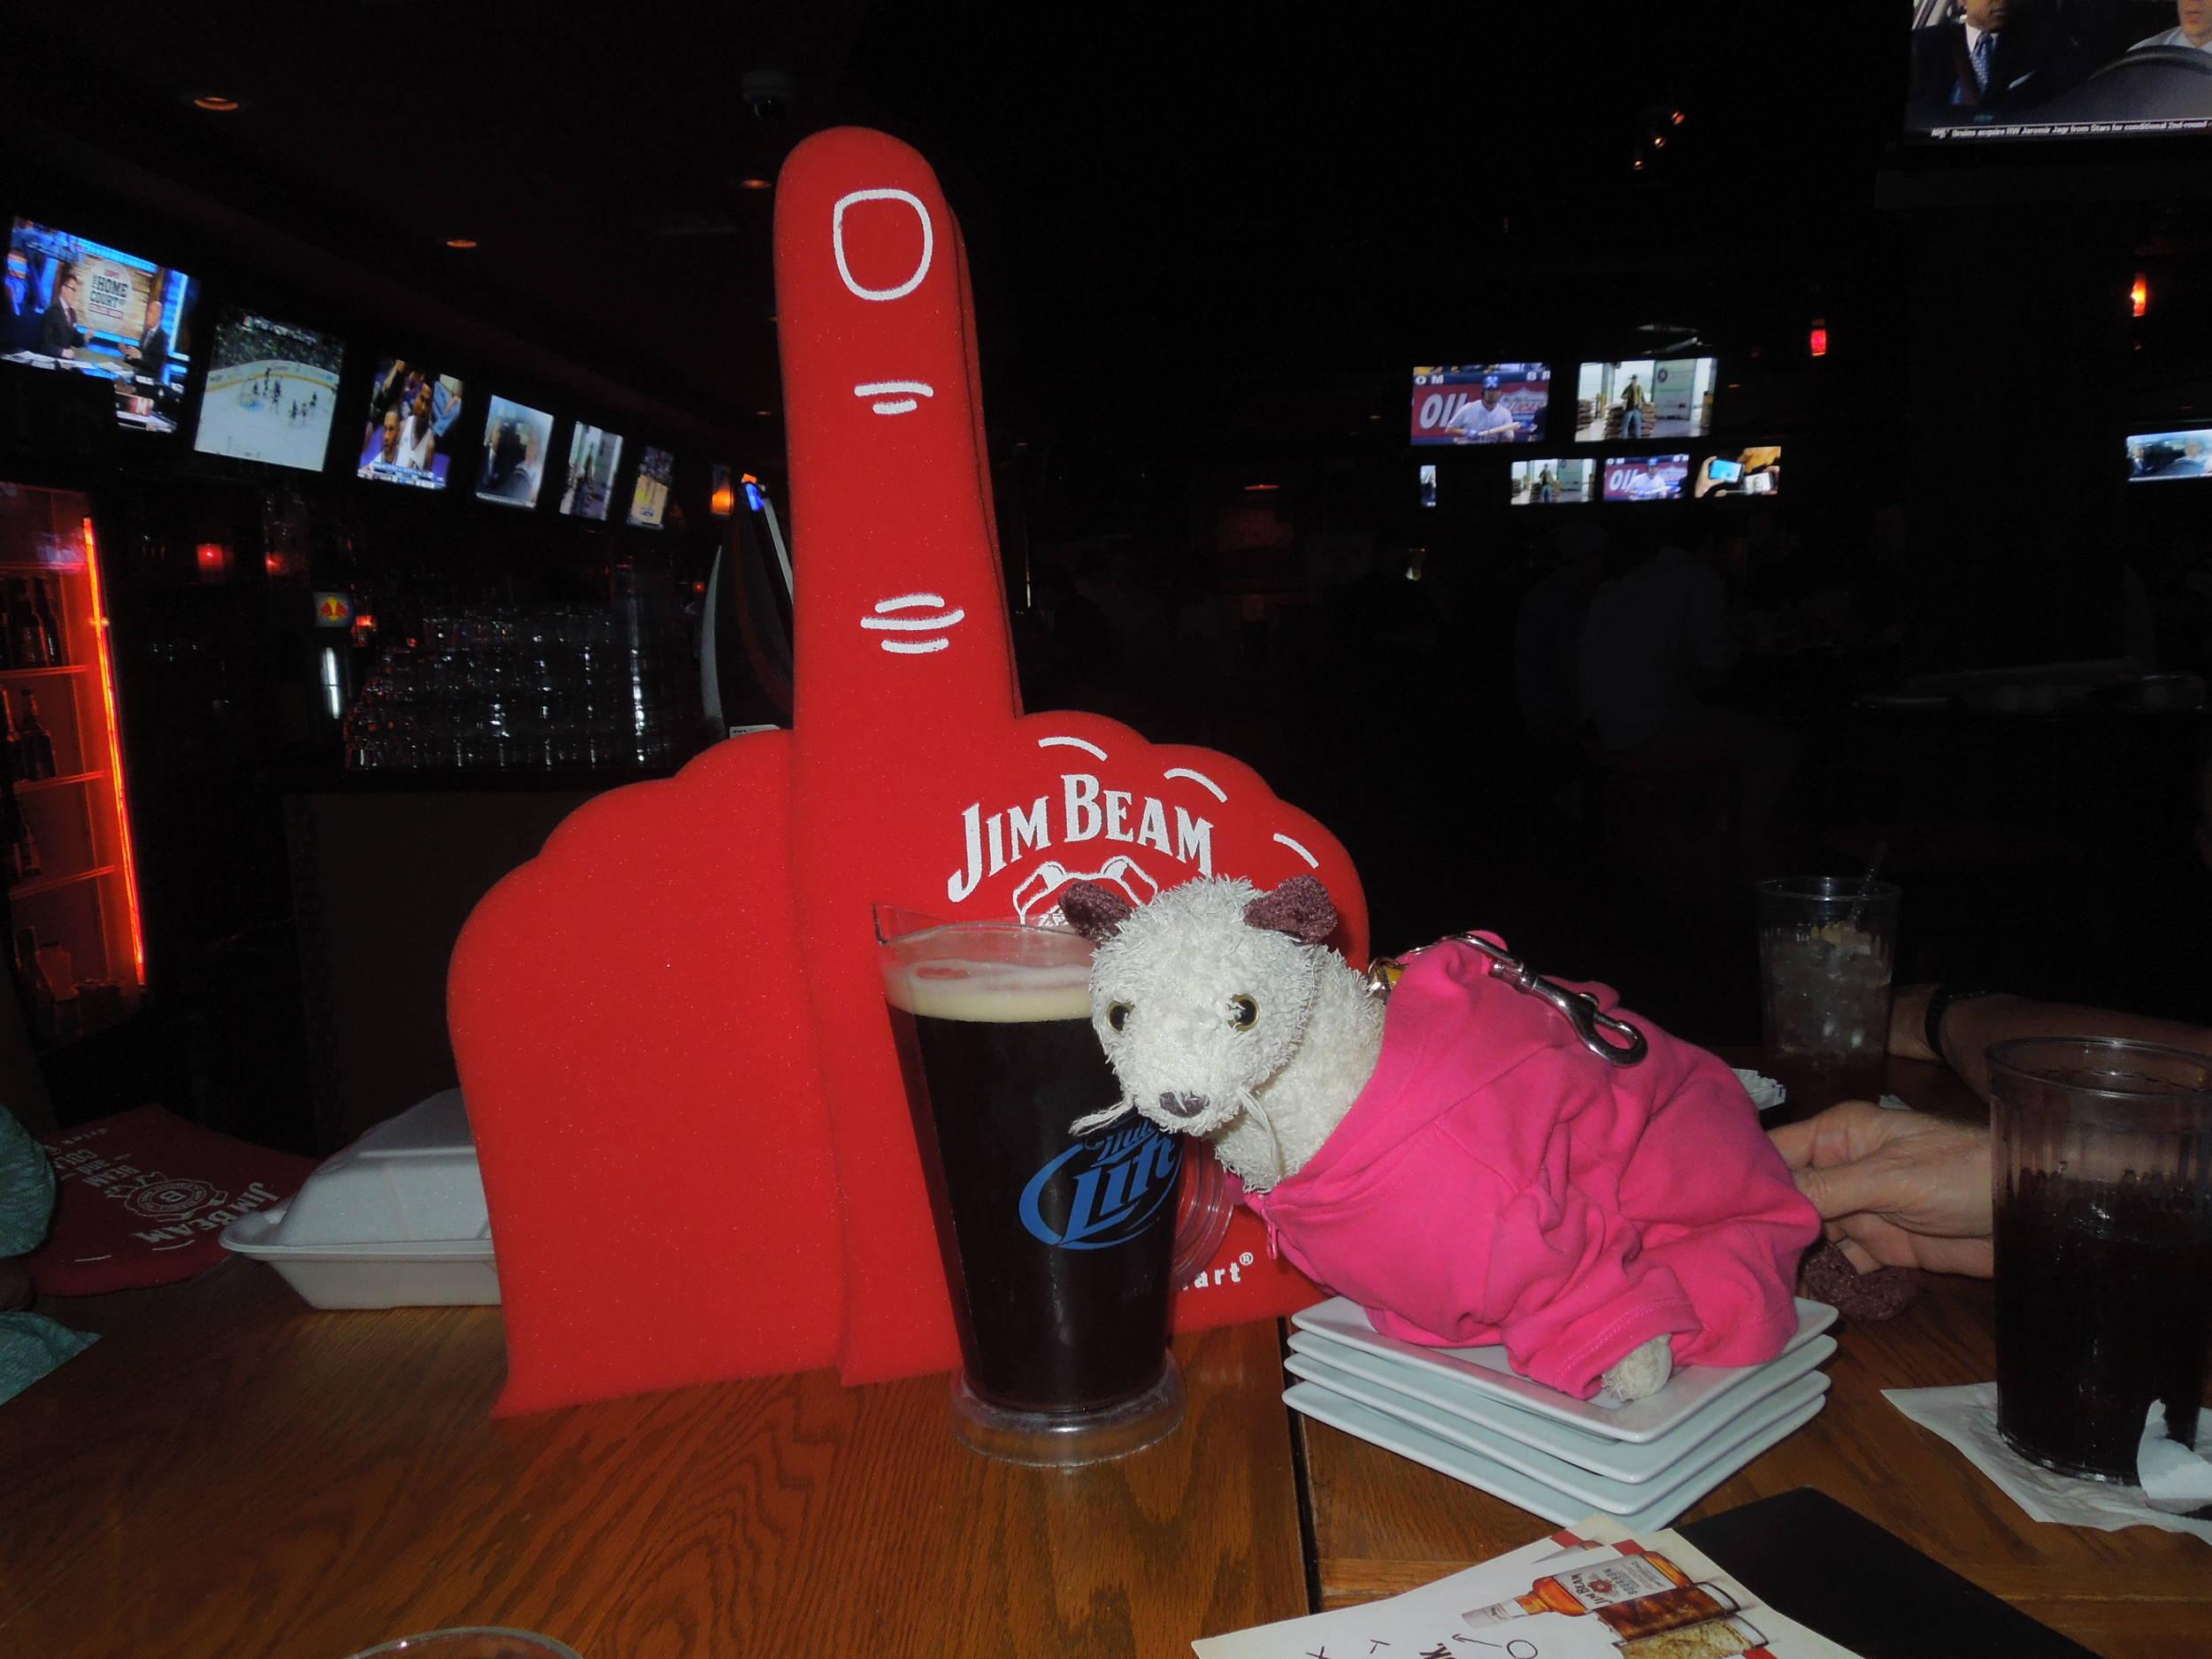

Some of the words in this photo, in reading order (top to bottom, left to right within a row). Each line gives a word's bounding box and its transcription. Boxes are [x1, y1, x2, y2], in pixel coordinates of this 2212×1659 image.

[2124, 121, 2167, 130] conditional
[2168, 119, 2208, 129] 2nd-round
[98, 275, 128, 298] HOME
[947, 796, 1052, 903] JIM
[1062, 773, 1215, 875] BEAM
